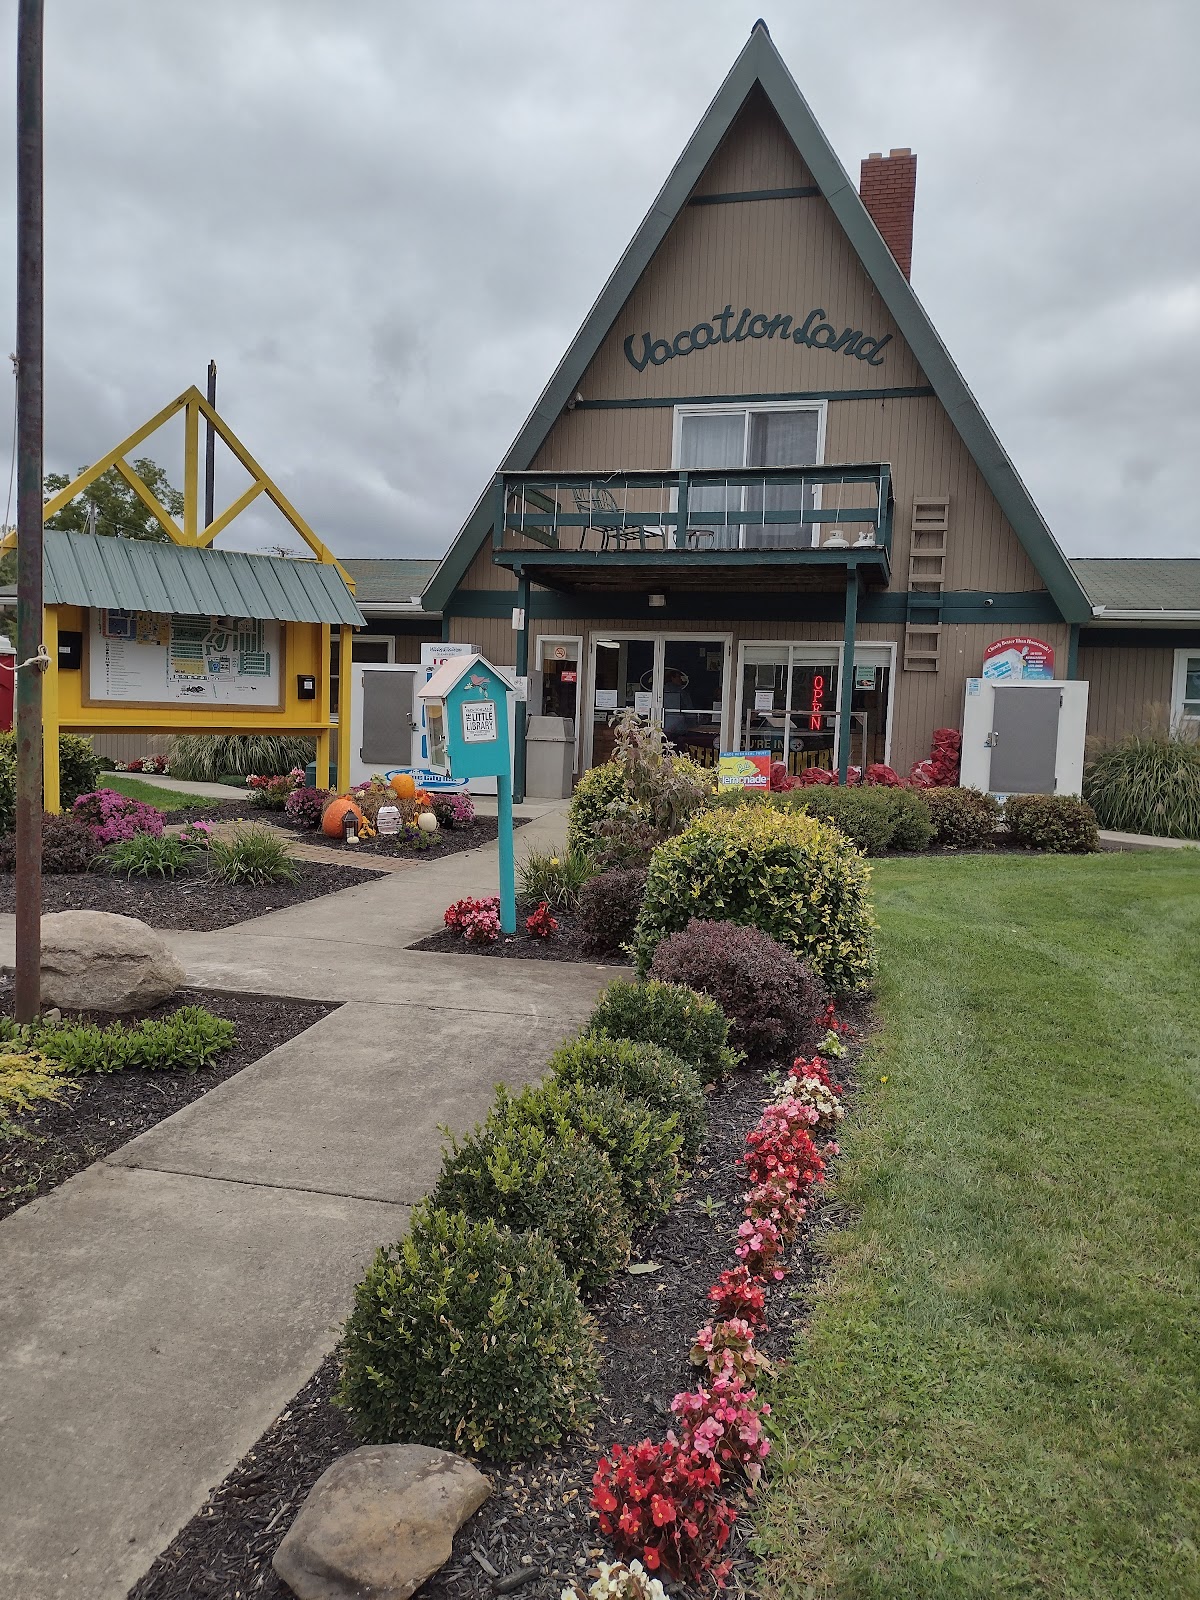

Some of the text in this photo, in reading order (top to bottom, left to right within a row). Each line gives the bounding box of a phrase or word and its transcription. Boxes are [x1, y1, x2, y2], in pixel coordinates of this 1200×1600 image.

[810, 675, 823, 731] OPEN
[472, 713, 493, 722] LITTLE
[466, 721, 494, 731] LIBRARY
[722, 774, 767, 784] lemonade
